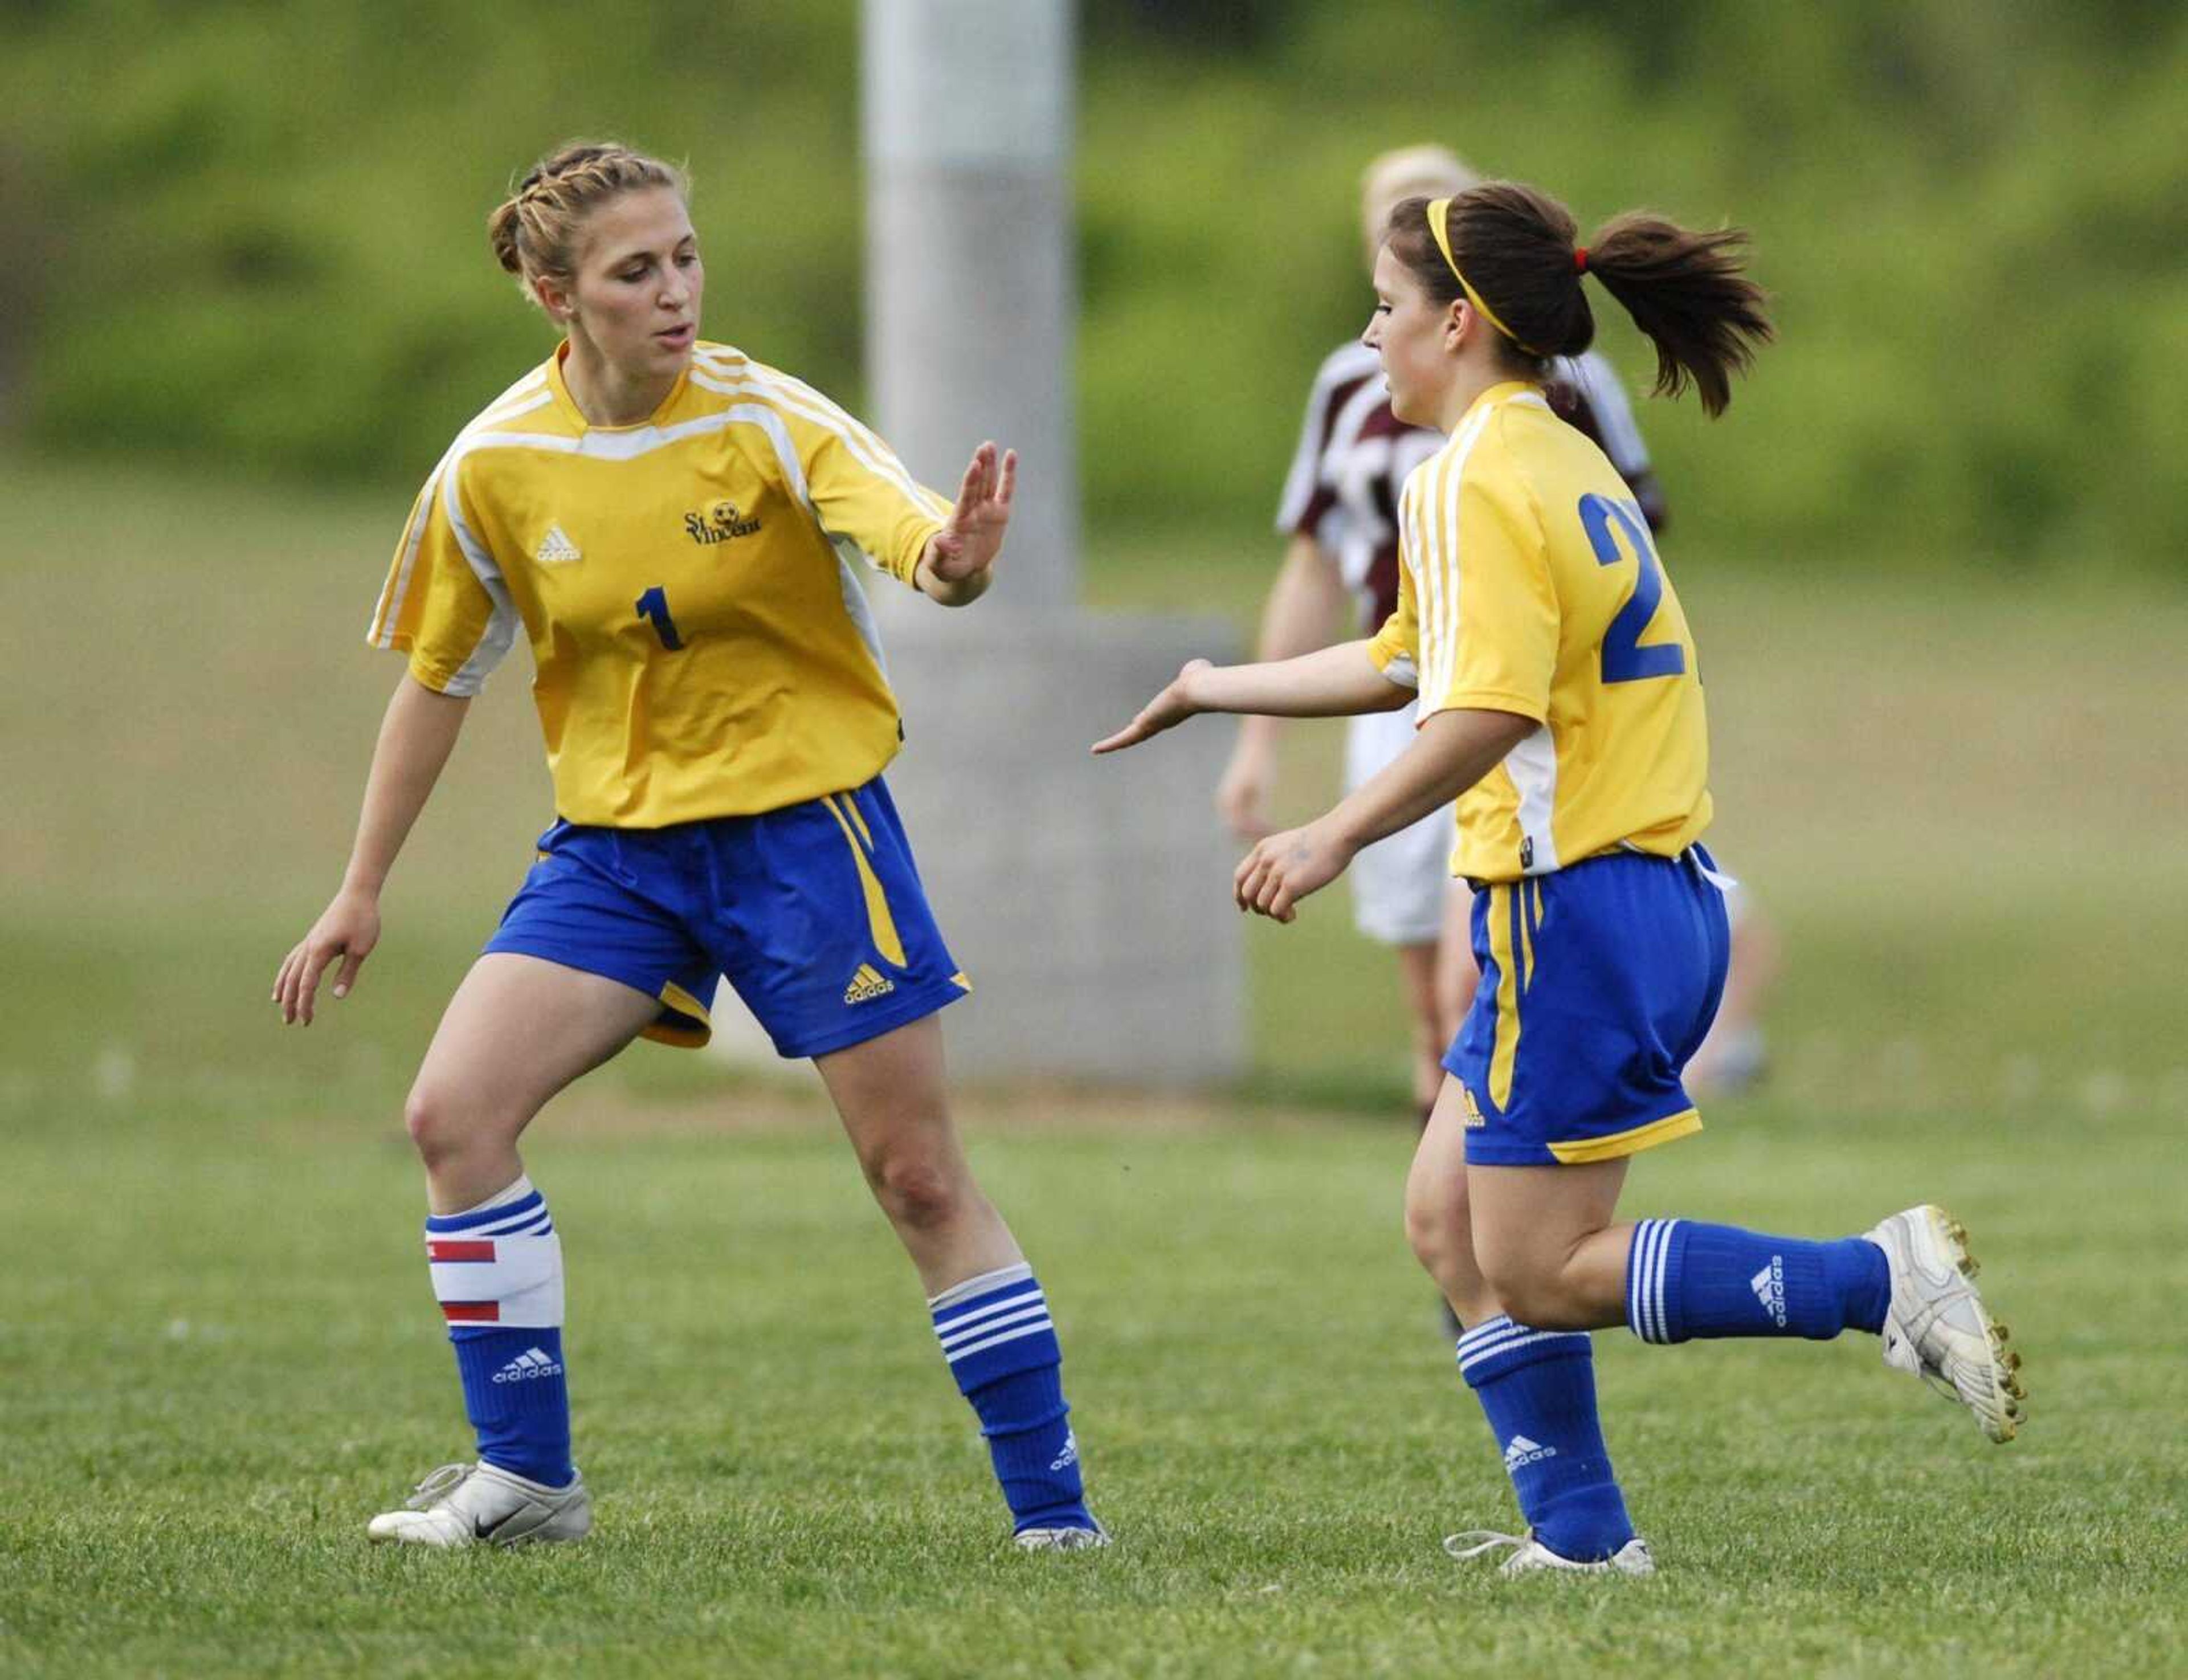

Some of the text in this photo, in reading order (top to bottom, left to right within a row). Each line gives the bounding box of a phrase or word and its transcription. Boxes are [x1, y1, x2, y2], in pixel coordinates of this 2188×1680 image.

[684, 512, 705, 532] St
[687, 517, 762, 544] Vincent
[1578, 494, 1701, 685] 2
[635, 585, 683, 651] 1
[844, 980, 894, 1004] adidas
[1768, 1255, 1787, 1327] adidas
[492, 1364, 561, 1383] adidas
